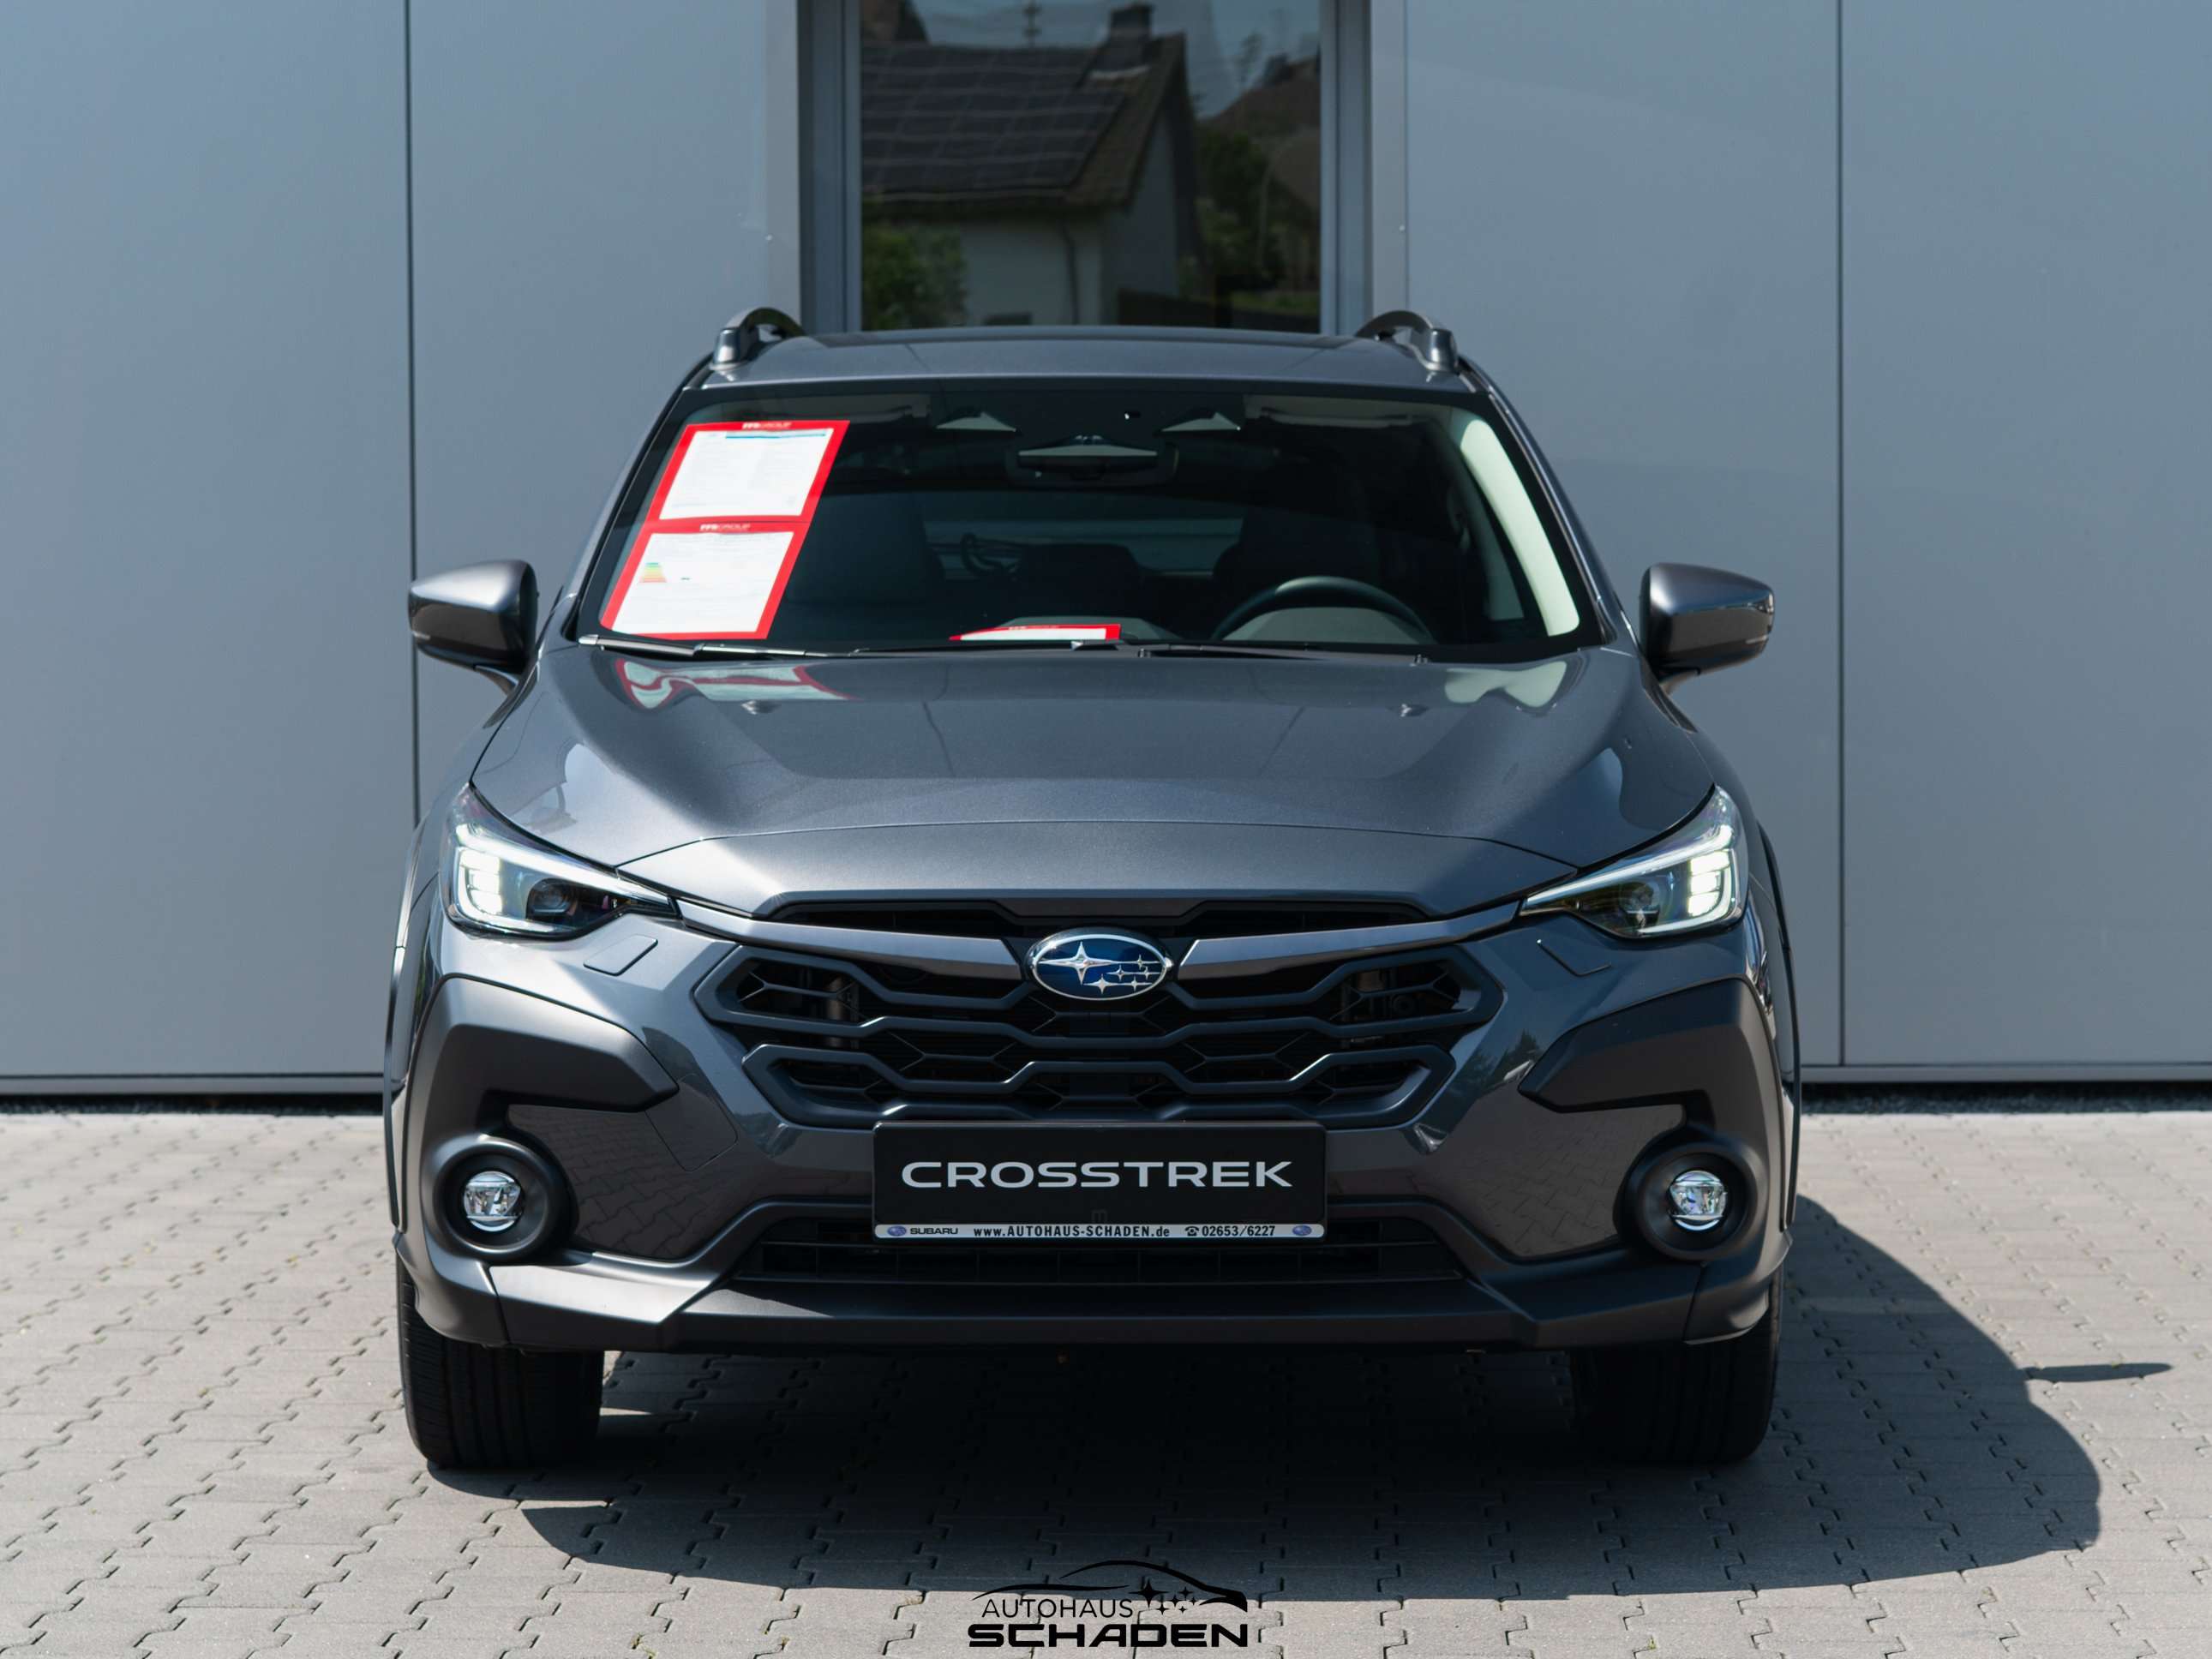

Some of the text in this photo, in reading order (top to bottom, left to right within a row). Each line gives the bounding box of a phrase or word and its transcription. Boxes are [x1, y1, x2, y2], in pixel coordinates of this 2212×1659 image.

[902, 1161, 1292, 1188] CROSSTREK
[974, 1225, 1170, 1237] www.AUTOHAUS-SCHADEN.de
[1202, 1225, 1275, 1237] 02653/6227
